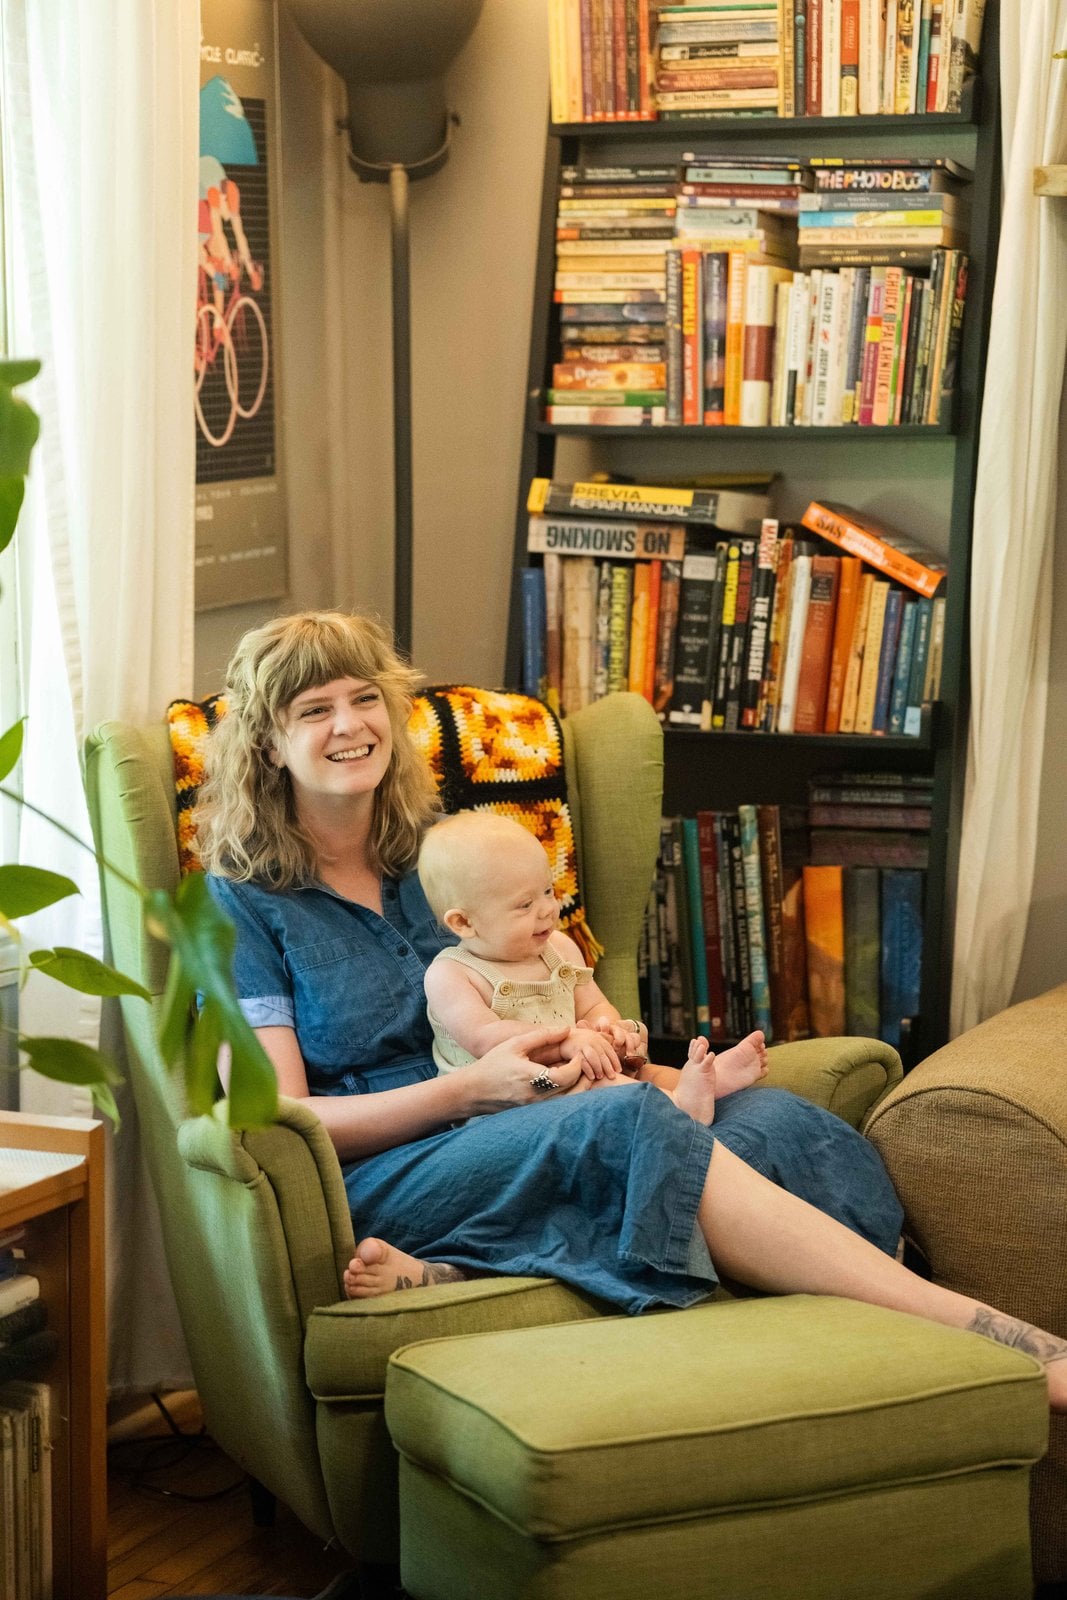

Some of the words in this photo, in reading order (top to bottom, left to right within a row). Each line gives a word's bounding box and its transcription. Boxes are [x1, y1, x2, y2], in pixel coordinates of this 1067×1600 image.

[683, 263, 696, 335] PETROPOLIS
[884, 272, 900, 311] CHUCK
[878, 324, 897, 388] PALAHNIUK
[570, 499, 624, 512] REPAIR
[625, 502, 688, 517] MANUAL
[574, 487, 641, 500] PREVIA
[546, 526, 636, 552] SMOKING
[643, 531, 671, 553] NO
[816, 514, 844, 538] SAS
[612, 570, 628, 621] CHUCK
[722, 561, 739, 625] WATCHMEN
[754, 597, 770, 620] THE
[747, 621, 767, 681] PUNISHER
[743, 854, 762, 914] VINCENT
[748, 915, 764, 942] VAN
[750, 947, 766, 984] GOGH
